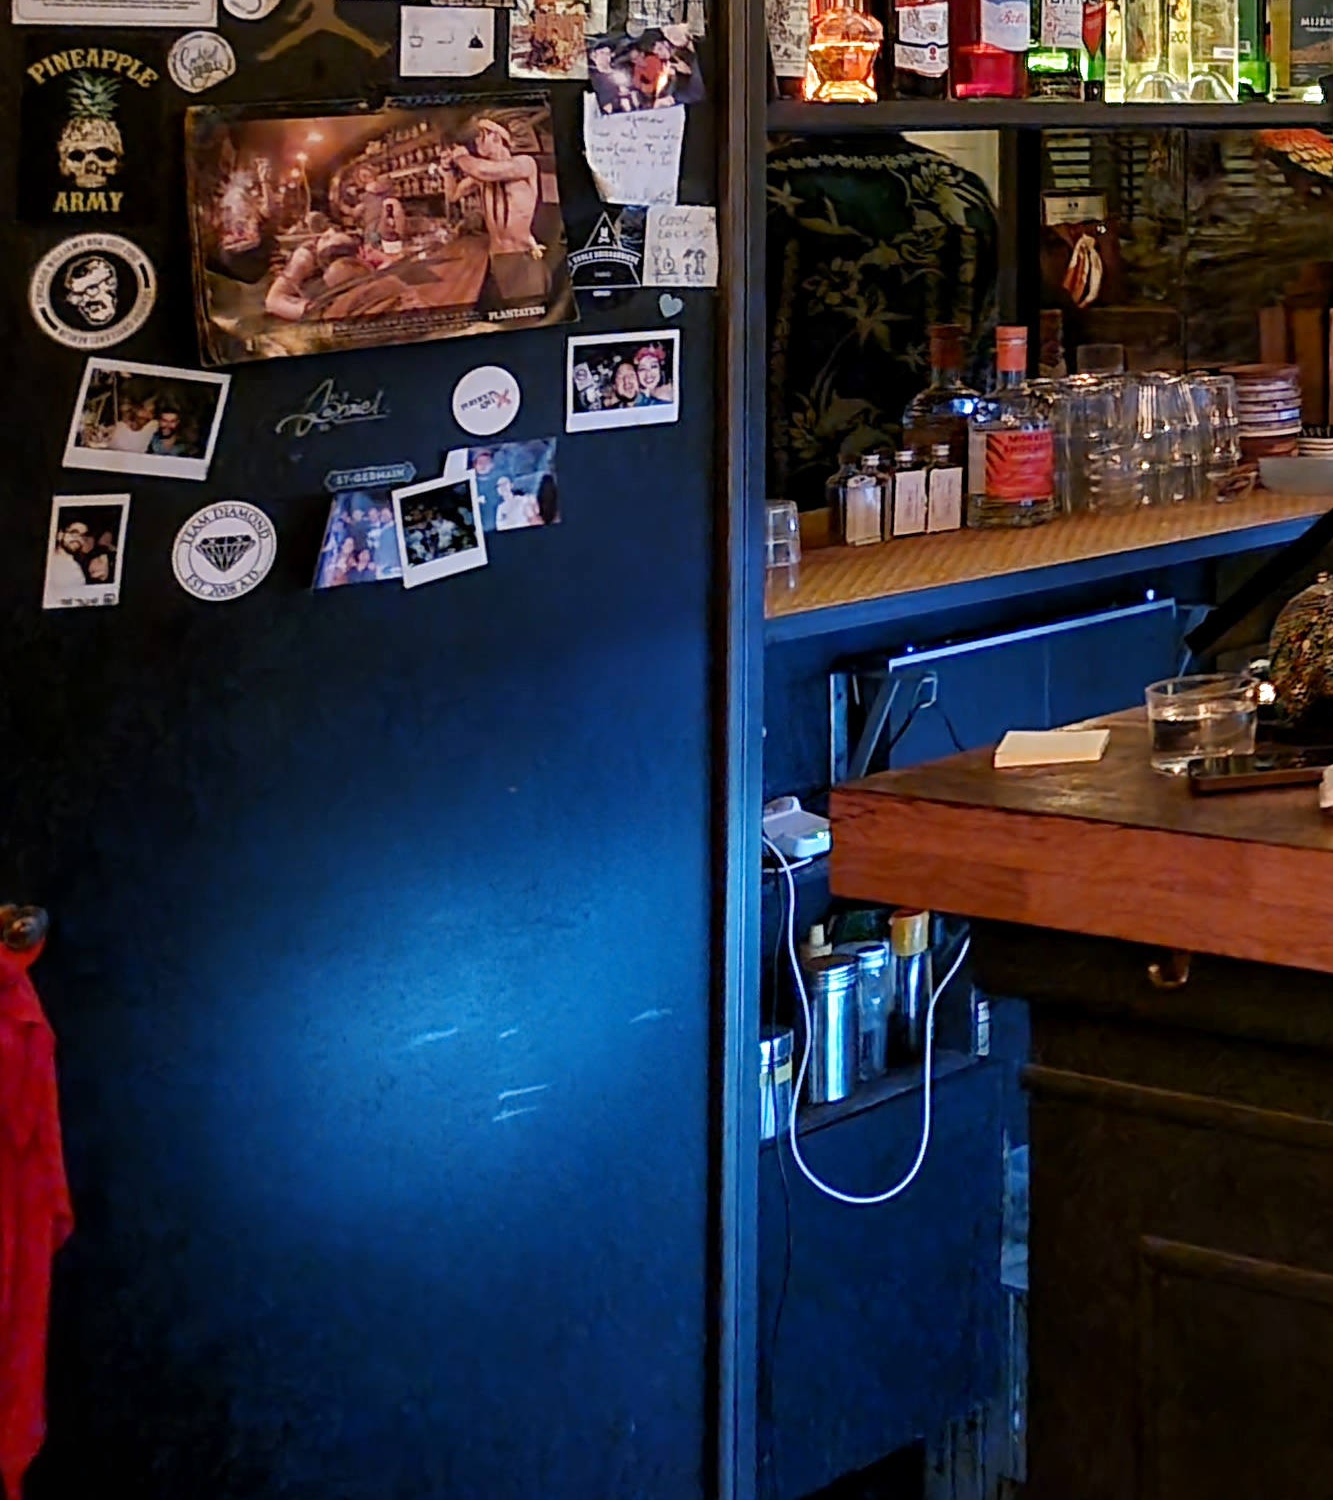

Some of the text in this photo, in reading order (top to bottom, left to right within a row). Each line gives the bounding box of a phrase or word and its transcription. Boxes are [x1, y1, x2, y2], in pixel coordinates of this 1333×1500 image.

[26, 47, 160, 89] PINEAPPLE
[52, 190, 124, 214] ARMY
[180, 505, 272, 548] TEAM DIAMOND
